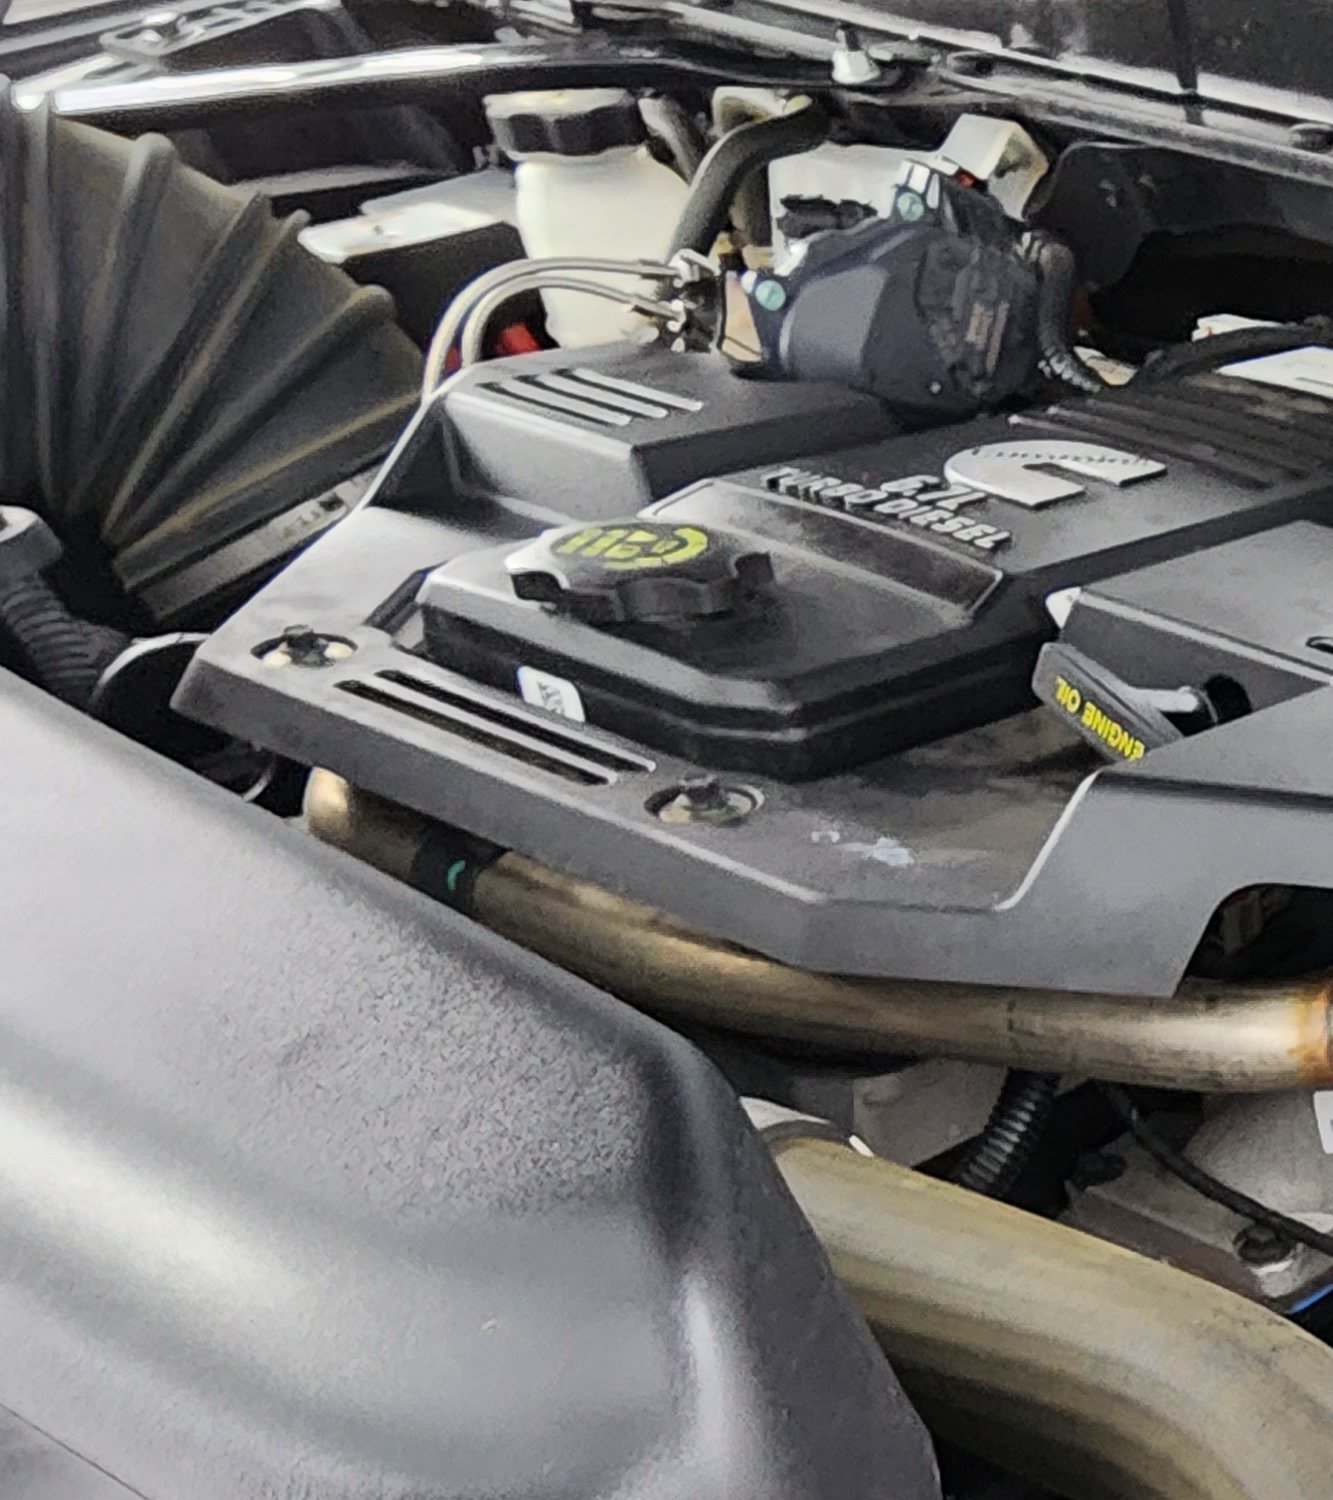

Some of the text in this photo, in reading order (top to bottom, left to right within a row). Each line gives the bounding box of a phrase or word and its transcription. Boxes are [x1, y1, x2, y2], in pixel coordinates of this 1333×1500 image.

[883, 474, 985, 510] 6.7L
[873, 496, 1010, 549] DIESEL
[1054, 676, 1145, 763] ENGINE OIL
